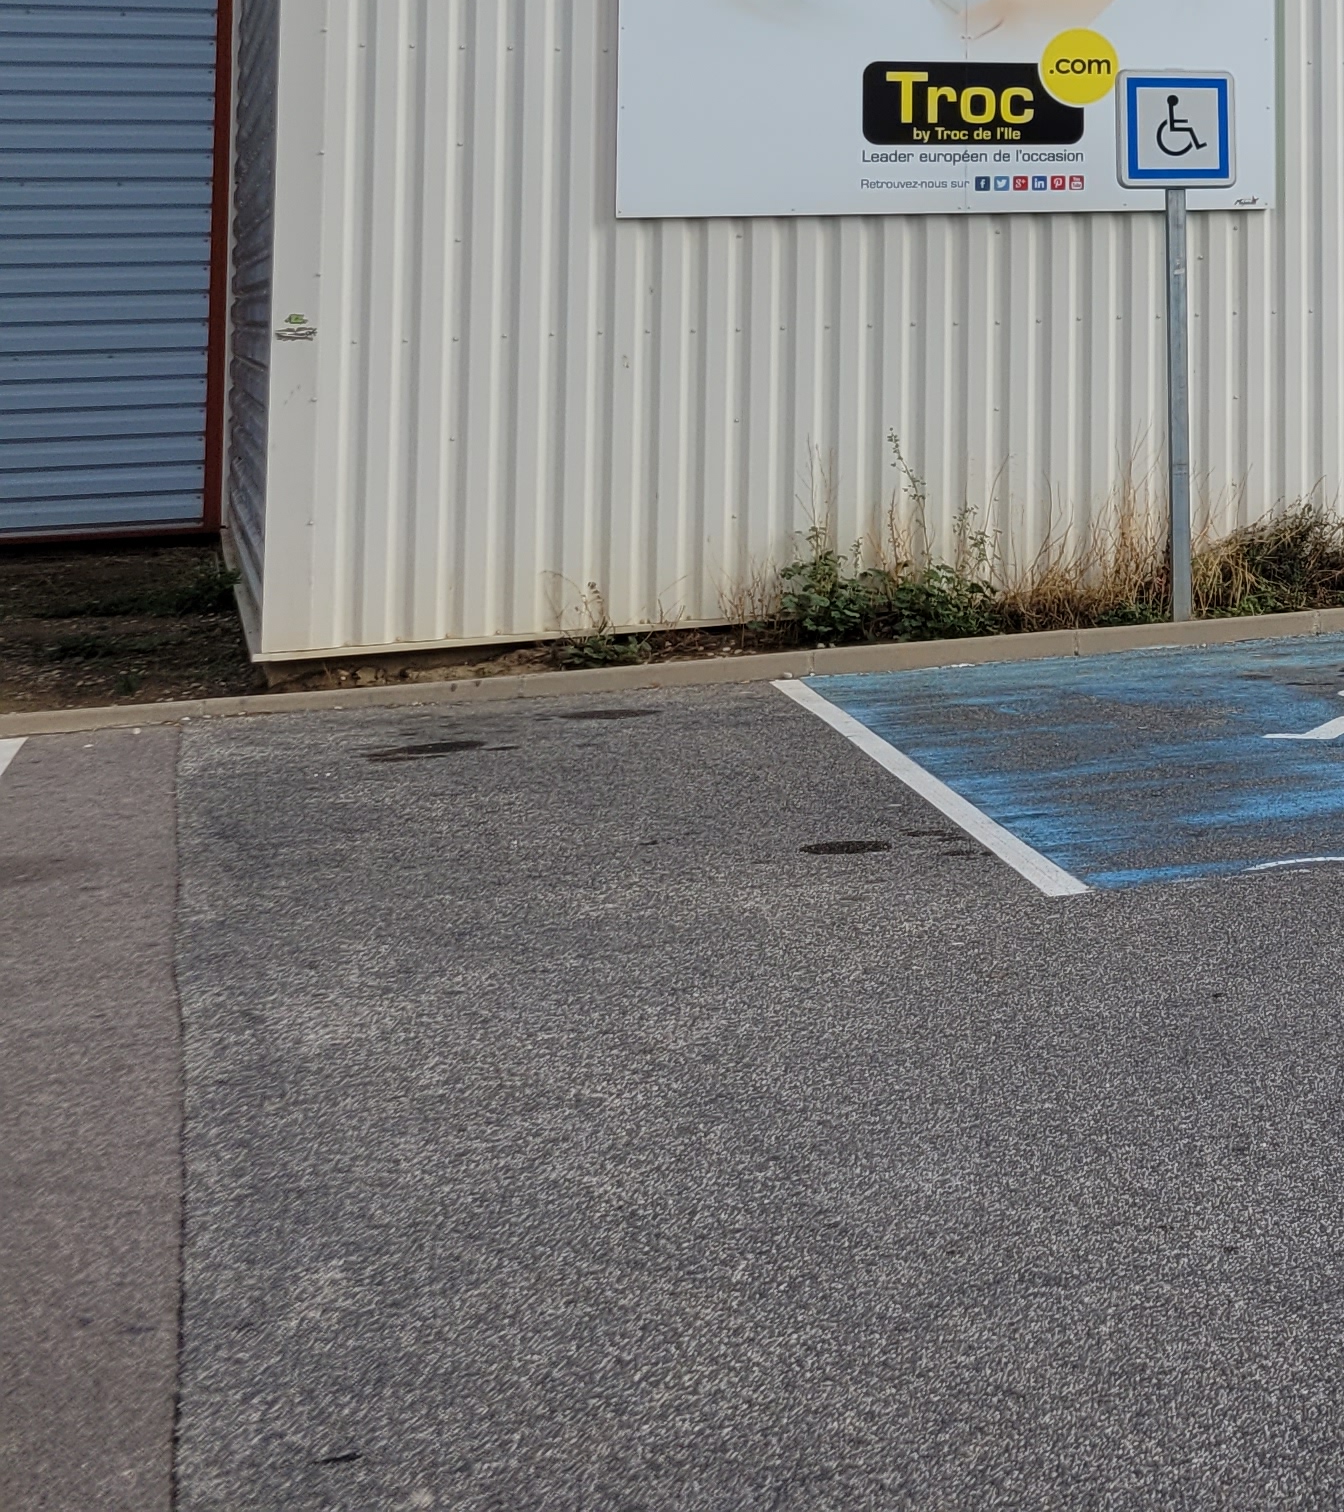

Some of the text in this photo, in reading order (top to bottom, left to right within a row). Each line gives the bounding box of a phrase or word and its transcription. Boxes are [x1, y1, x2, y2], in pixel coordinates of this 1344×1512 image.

[1049, 55, 1111, 76] .com
[886, 71, 1035, 124] Troc
[912, 127, 931, 144] by
[934, 127, 969, 141] Troc
[973, 127, 992, 141] de
[862, 149, 1084, 167] Leader européen de l'occasion
[861, 178, 970, 189] Retrouvez-nous sur
